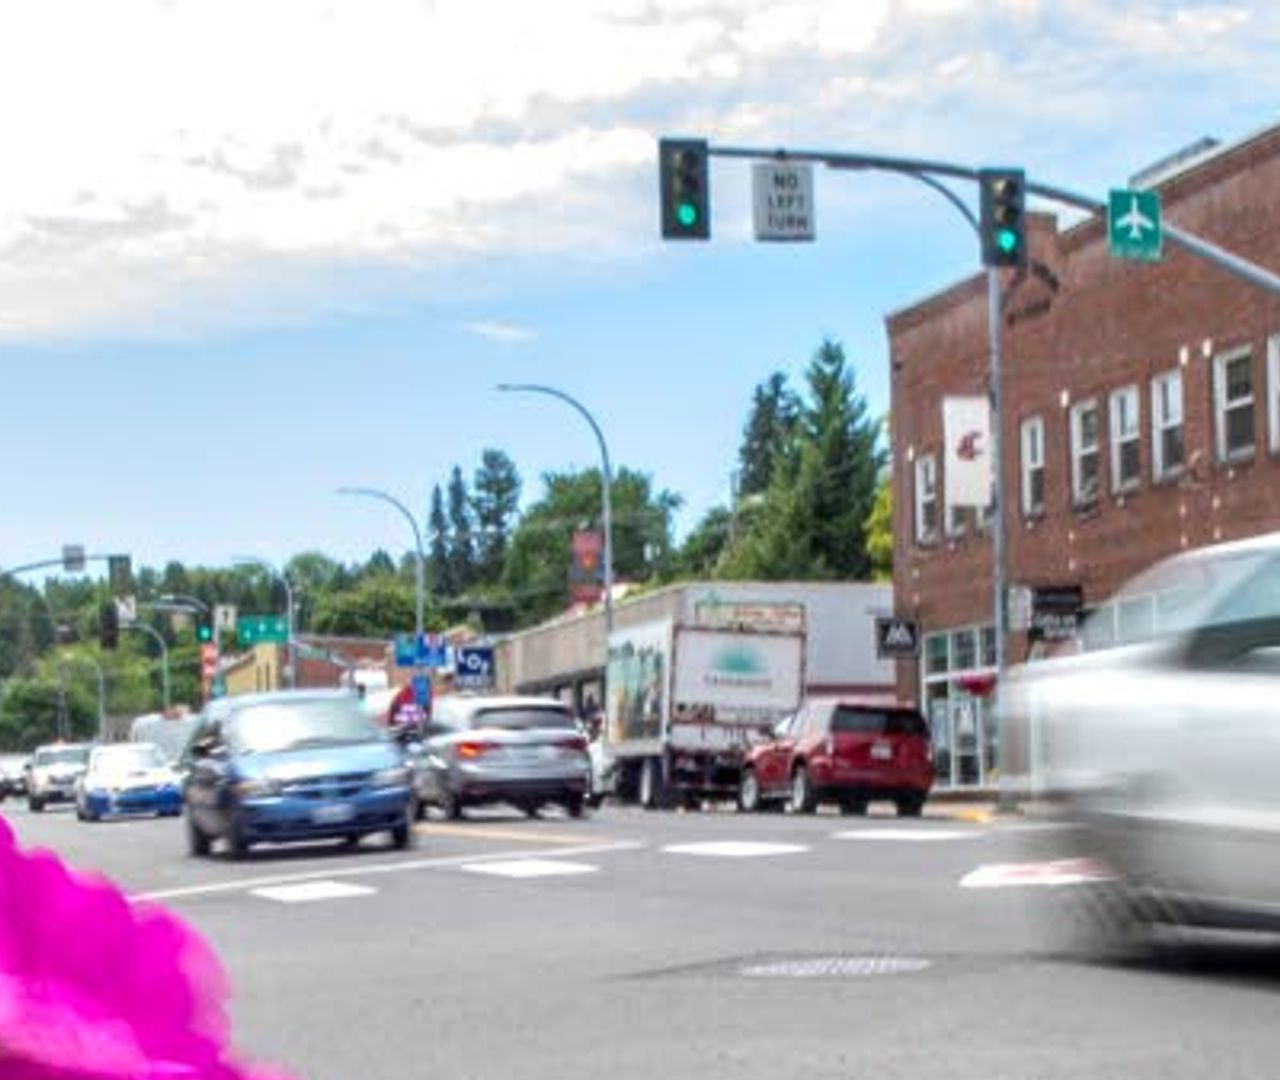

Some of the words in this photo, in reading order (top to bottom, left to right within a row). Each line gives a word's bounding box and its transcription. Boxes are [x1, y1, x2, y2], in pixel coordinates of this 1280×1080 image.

[773, 172, 798, 189] NO
[767, 194, 805, 209] LEFT
[767, 213, 808, 232] TURN
